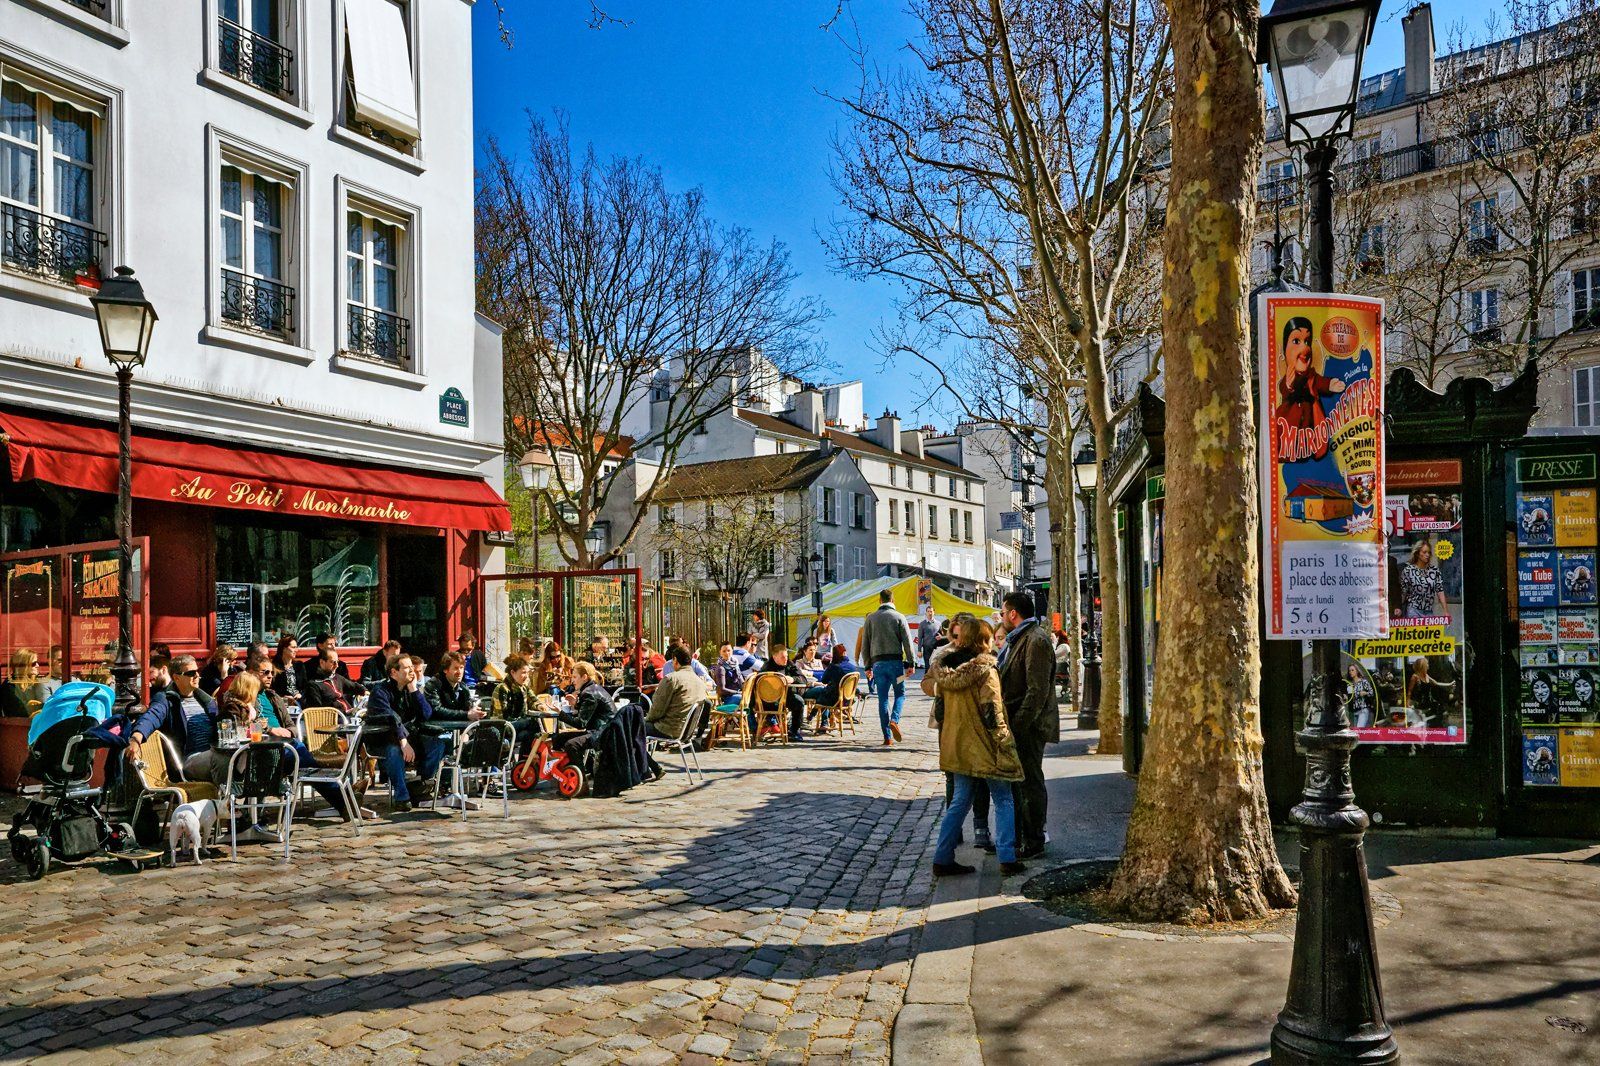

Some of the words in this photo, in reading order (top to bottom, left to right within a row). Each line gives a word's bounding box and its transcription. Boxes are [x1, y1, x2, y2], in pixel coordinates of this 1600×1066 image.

[1337, 335, 1344, 343] DE
[446, 402, 462, 410] PLACE
[443, 412, 466, 422] ABBESSES
[1277, 378, 1376, 462] MARIONNETTES
[1329, 420, 1375, 452] GUIGNOL
[1342, 446, 1352, 457] ET
[1353, 438, 1375, 450] MIMI
[1345, 456, 1354, 464] LA
[1355, 450, 1376, 460] PETITE
[1350, 460, 1371, 470] SOURIS
[1530, 460, 1584, 480] PRESSE
[170, 476, 218, 501] Au
[227, 481, 285, 507] Petit
[293, 490, 412, 520] Montmartre
[1556, 515, 1596, 525] Clinton
[83, 555, 90, 563] LE
[1290, 553, 1325, 571] paris
[1335, 554, 1348, 567] 18
[1352, 557, 1374, 568] eme
[1290, 572, 1317, 590] place
[1320, 571, 1336, 586] des
[1339, 572, 1374, 586] abbesses
[1518, 571, 1532, 581] You
[1534, 570, 1553, 580] Tube
[1316, 595, 1334, 604] lundi
[508, 597, 540, 618] SPRITZ
[1290, 607, 1300, 624] 5
[1306, 611, 1312, 623] et
[1319, 608, 1329, 623] 6
[1425, 617, 1449, 625] ENORA
[1291, 627, 1327, 635] avril
[1395, 627, 1441, 641] histoire
[1357, 642, 1407, 656] d'amour
[1408, 640, 1452, 653] secrète
[1565, 705, 1588, 713] hackers
[1561, 754, 1600, 765] Clinton
